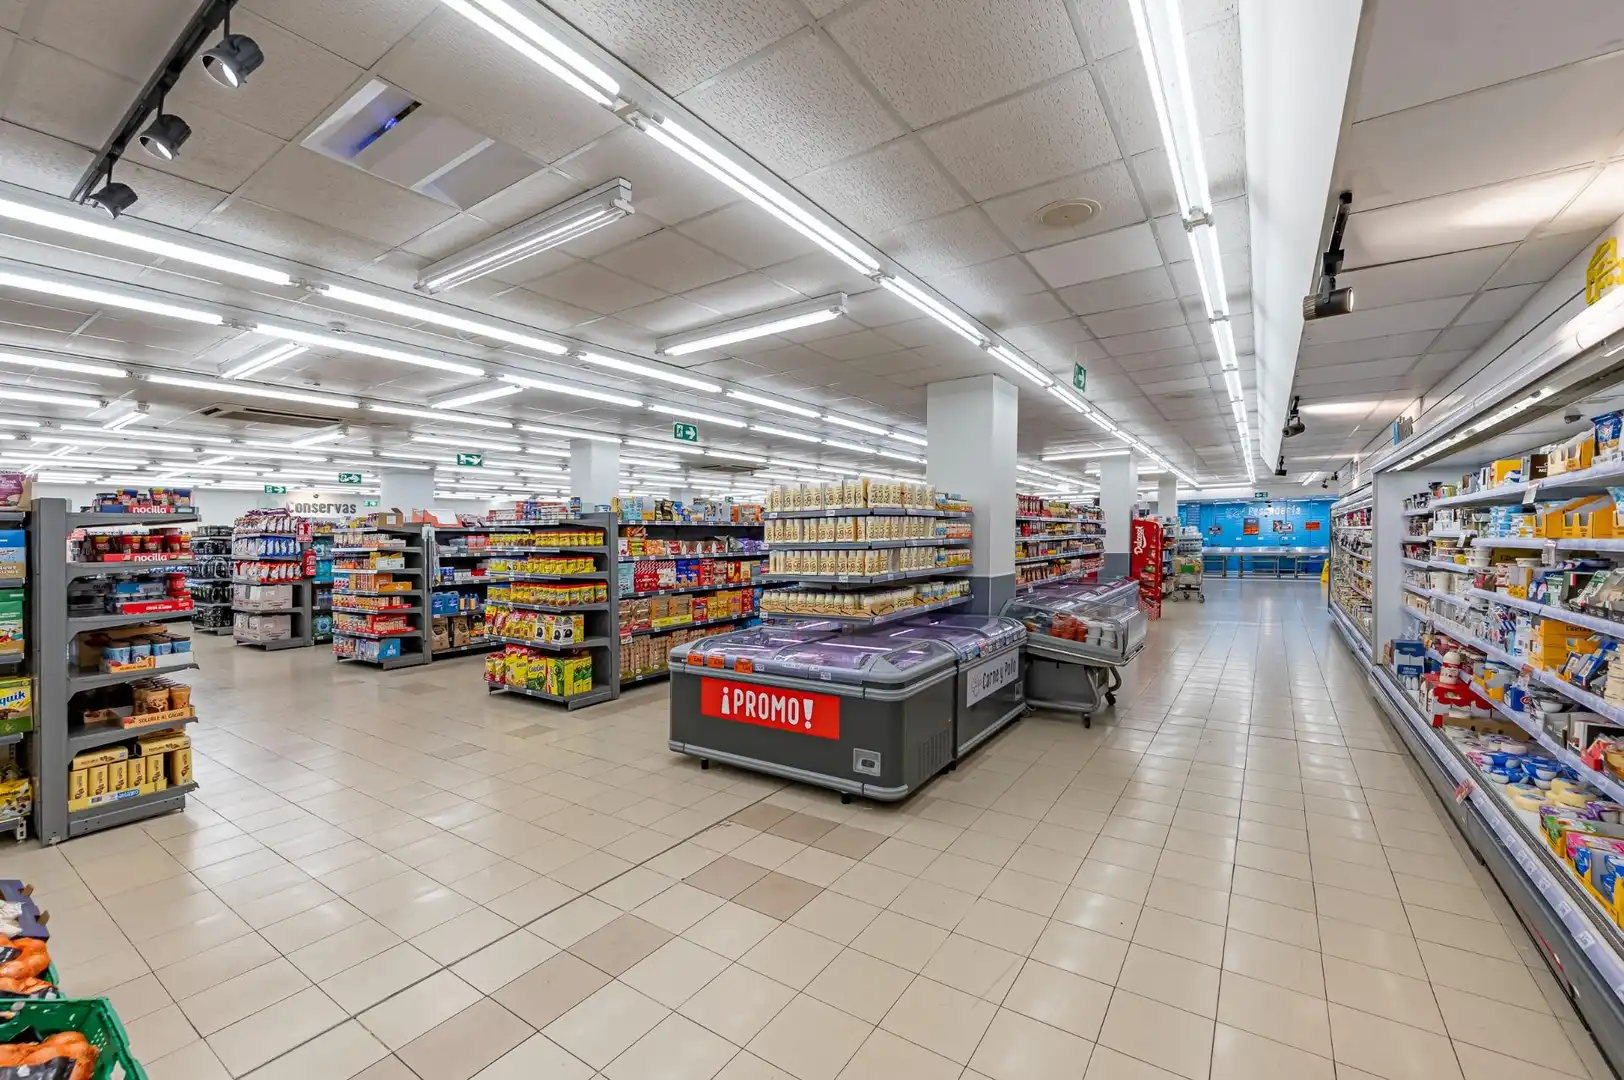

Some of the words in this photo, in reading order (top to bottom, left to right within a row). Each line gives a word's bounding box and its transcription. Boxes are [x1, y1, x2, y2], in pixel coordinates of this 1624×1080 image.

[132, 505, 167, 514] nocilla
[286, 501, 357, 515] Conservas
[134, 552, 168, 562] nocilla
[982, 669, 999, 690] Carne
[999, 666, 1004, 684] y
[721, 686, 814, 729] ¡PROMO!
